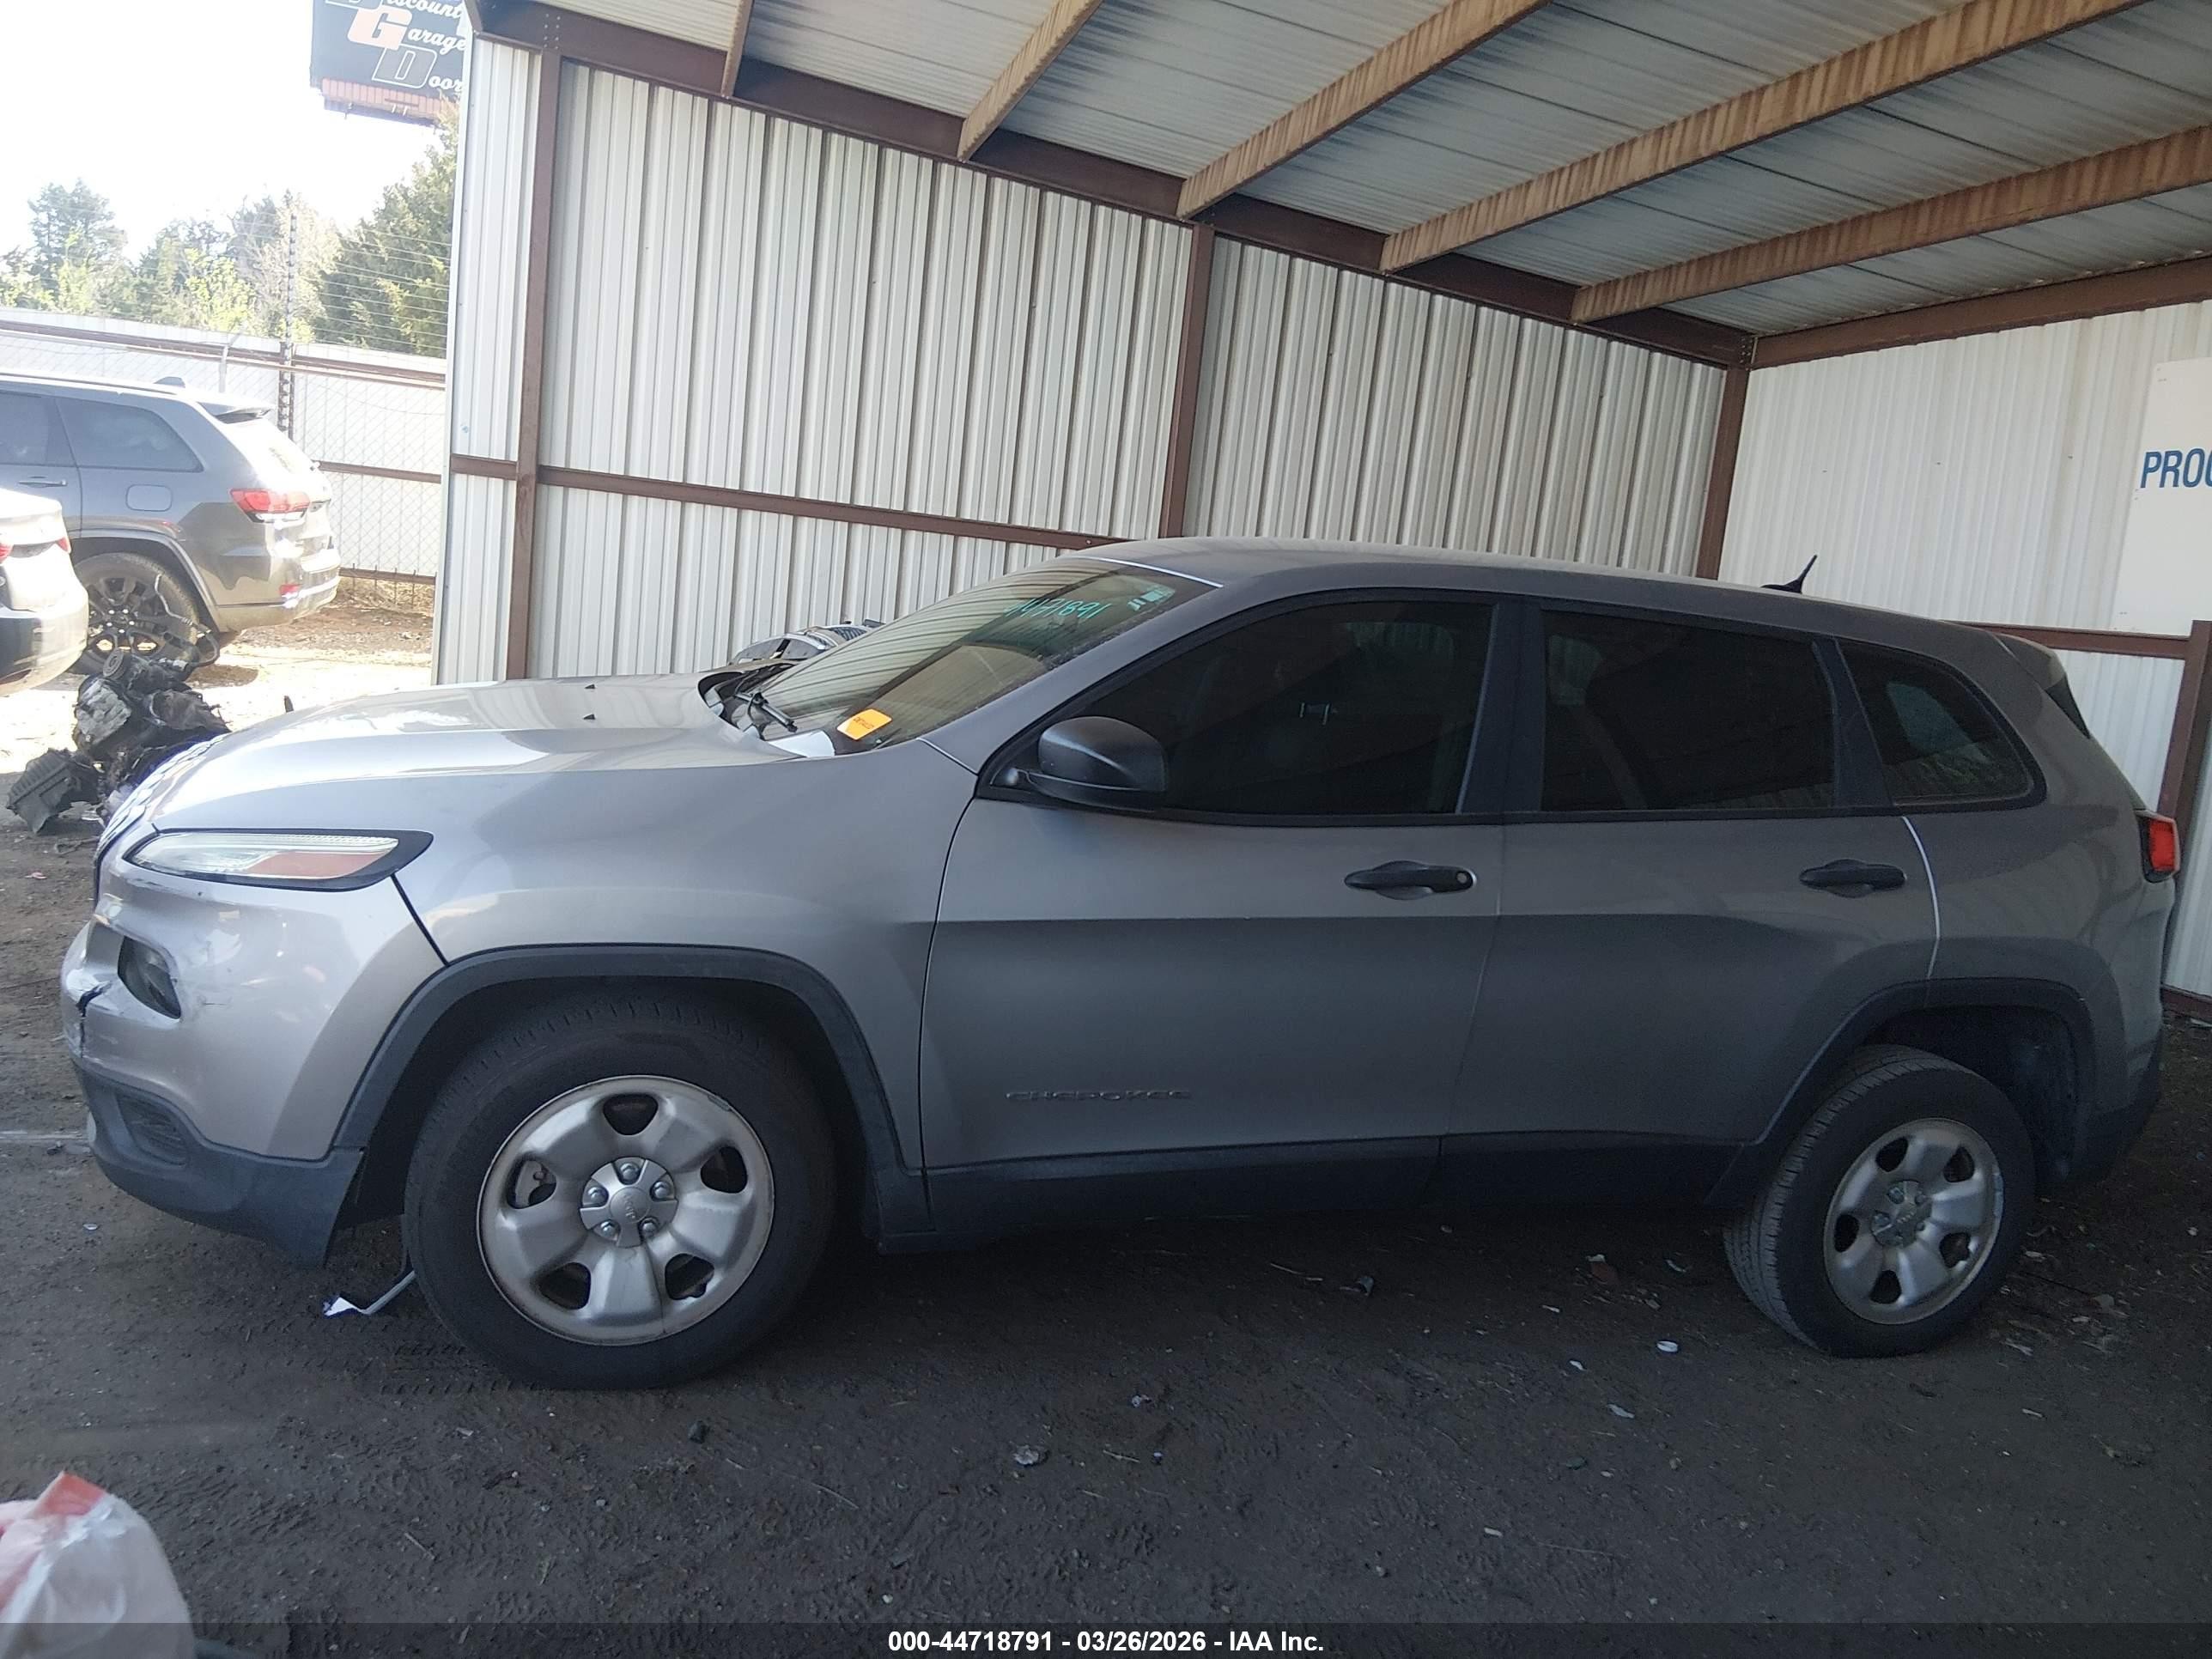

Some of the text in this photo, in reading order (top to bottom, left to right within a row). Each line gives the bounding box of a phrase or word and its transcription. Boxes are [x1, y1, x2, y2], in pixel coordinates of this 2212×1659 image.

[347, 5, 467, 56] Garage
[2140, 447, 2212, 489] PRO
[1005, 1090, 1192, 1101] CHEROKEE
